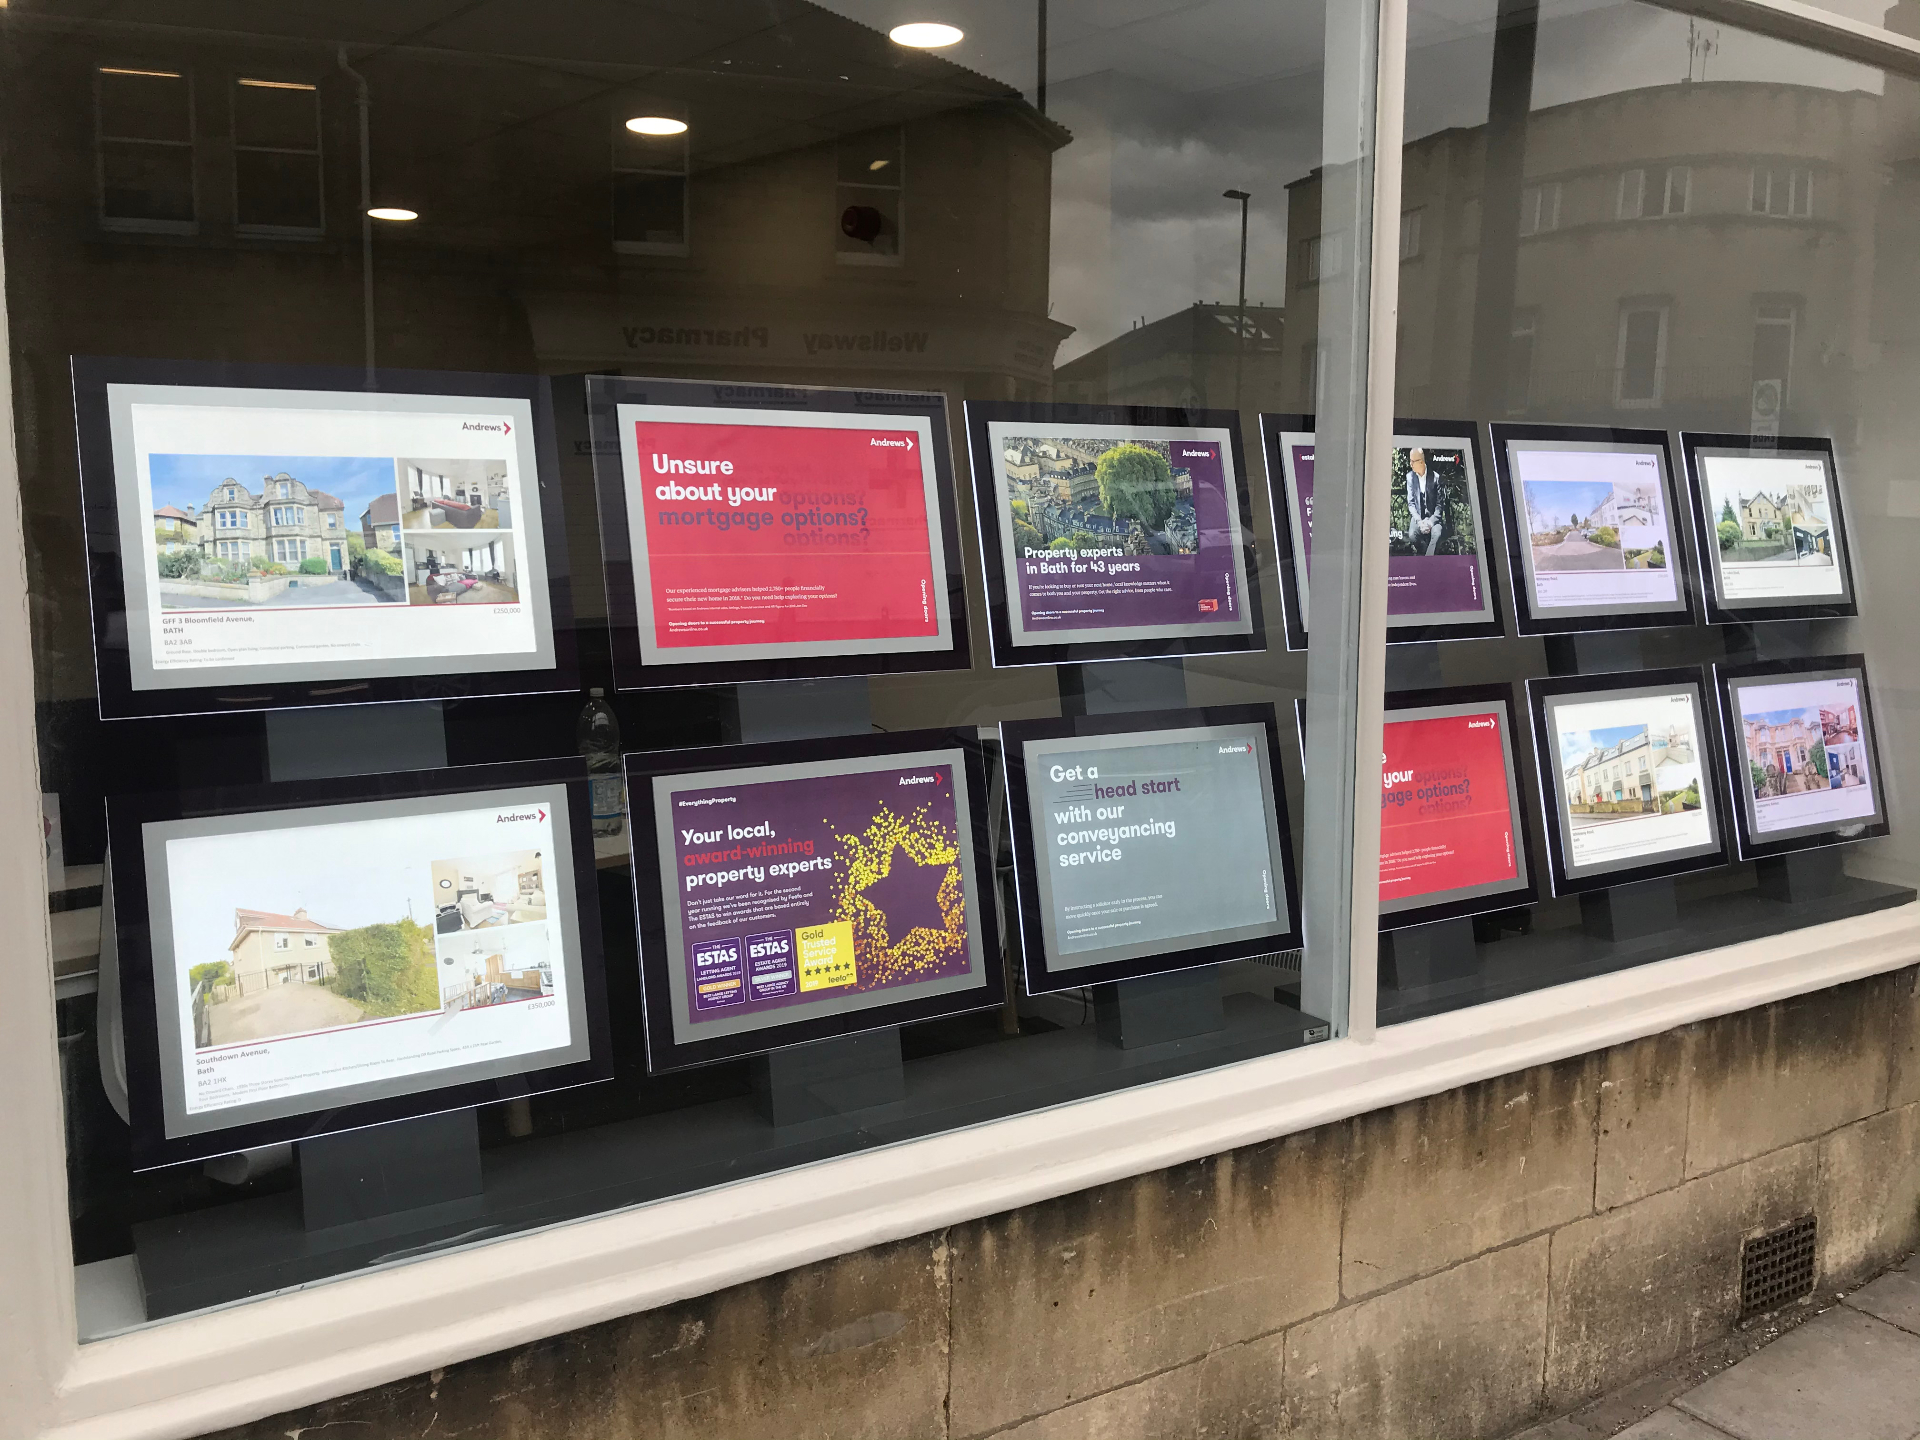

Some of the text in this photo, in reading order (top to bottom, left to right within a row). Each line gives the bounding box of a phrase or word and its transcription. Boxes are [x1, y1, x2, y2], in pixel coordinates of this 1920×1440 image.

[462, 422, 502, 431] Andrews
[870, 438, 906, 446] Andrews
[1182, 449, 1210, 457] Andrews
[652, 454, 734, 475] Unsure
[656, 481, 866, 510] about your options?
[658, 506, 868, 531] mortgage options?
[783, 528, 870, 546] options?
[1024, 547, 1123, 560] Property experts
[1026, 561, 1140, 576] in Bath for 43 years
[1468, 720, 1490, 728] Andrews
[1050, 765, 1098, 782] Get a
[1384, 766, 1468, 788] your options?
[898, 776, 934, 786] Andrews
[1094, 778, 1181, 800] head start
[1381, 779, 1470, 809] gage options?
[678, 796, 737, 807] #EverythingProperty
[1418, 795, 1472, 816] options?
[496, 813, 536, 823] Andrews
[1054, 805, 1124, 824] with our
[681, 821, 776, 845] Your local,
[1057, 818, 1176, 846] conveyancing
[684, 838, 814, 866] award-winning
[1059, 845, 1122, 867] service
[686, 857, 832, 891] property experts
[752, 896, 780, 905] recognised
[732, 908, 752, 916] awards
[707, 918, 732, 927] feedback
[748, 913, 776, 921] customers.
[802, 930, 824, 940] Gold
[750, 940, 789, 958] ESTAS
[802, 937, 836, 948] Trusted
[696, 948, 738, 966] ESTAS
[802, 947, 836, 958] Service
[804, 956, 834, 968] Award
[806, 980, 818, 988] 2019
[527, 1000, 556, 1010] £350,000
[196, 1049, 270, 1065] Southdown Avenue,
[197, 1067, 215, 1075] Bath
[198, 1077, 227, 1087] BA2 1HX
